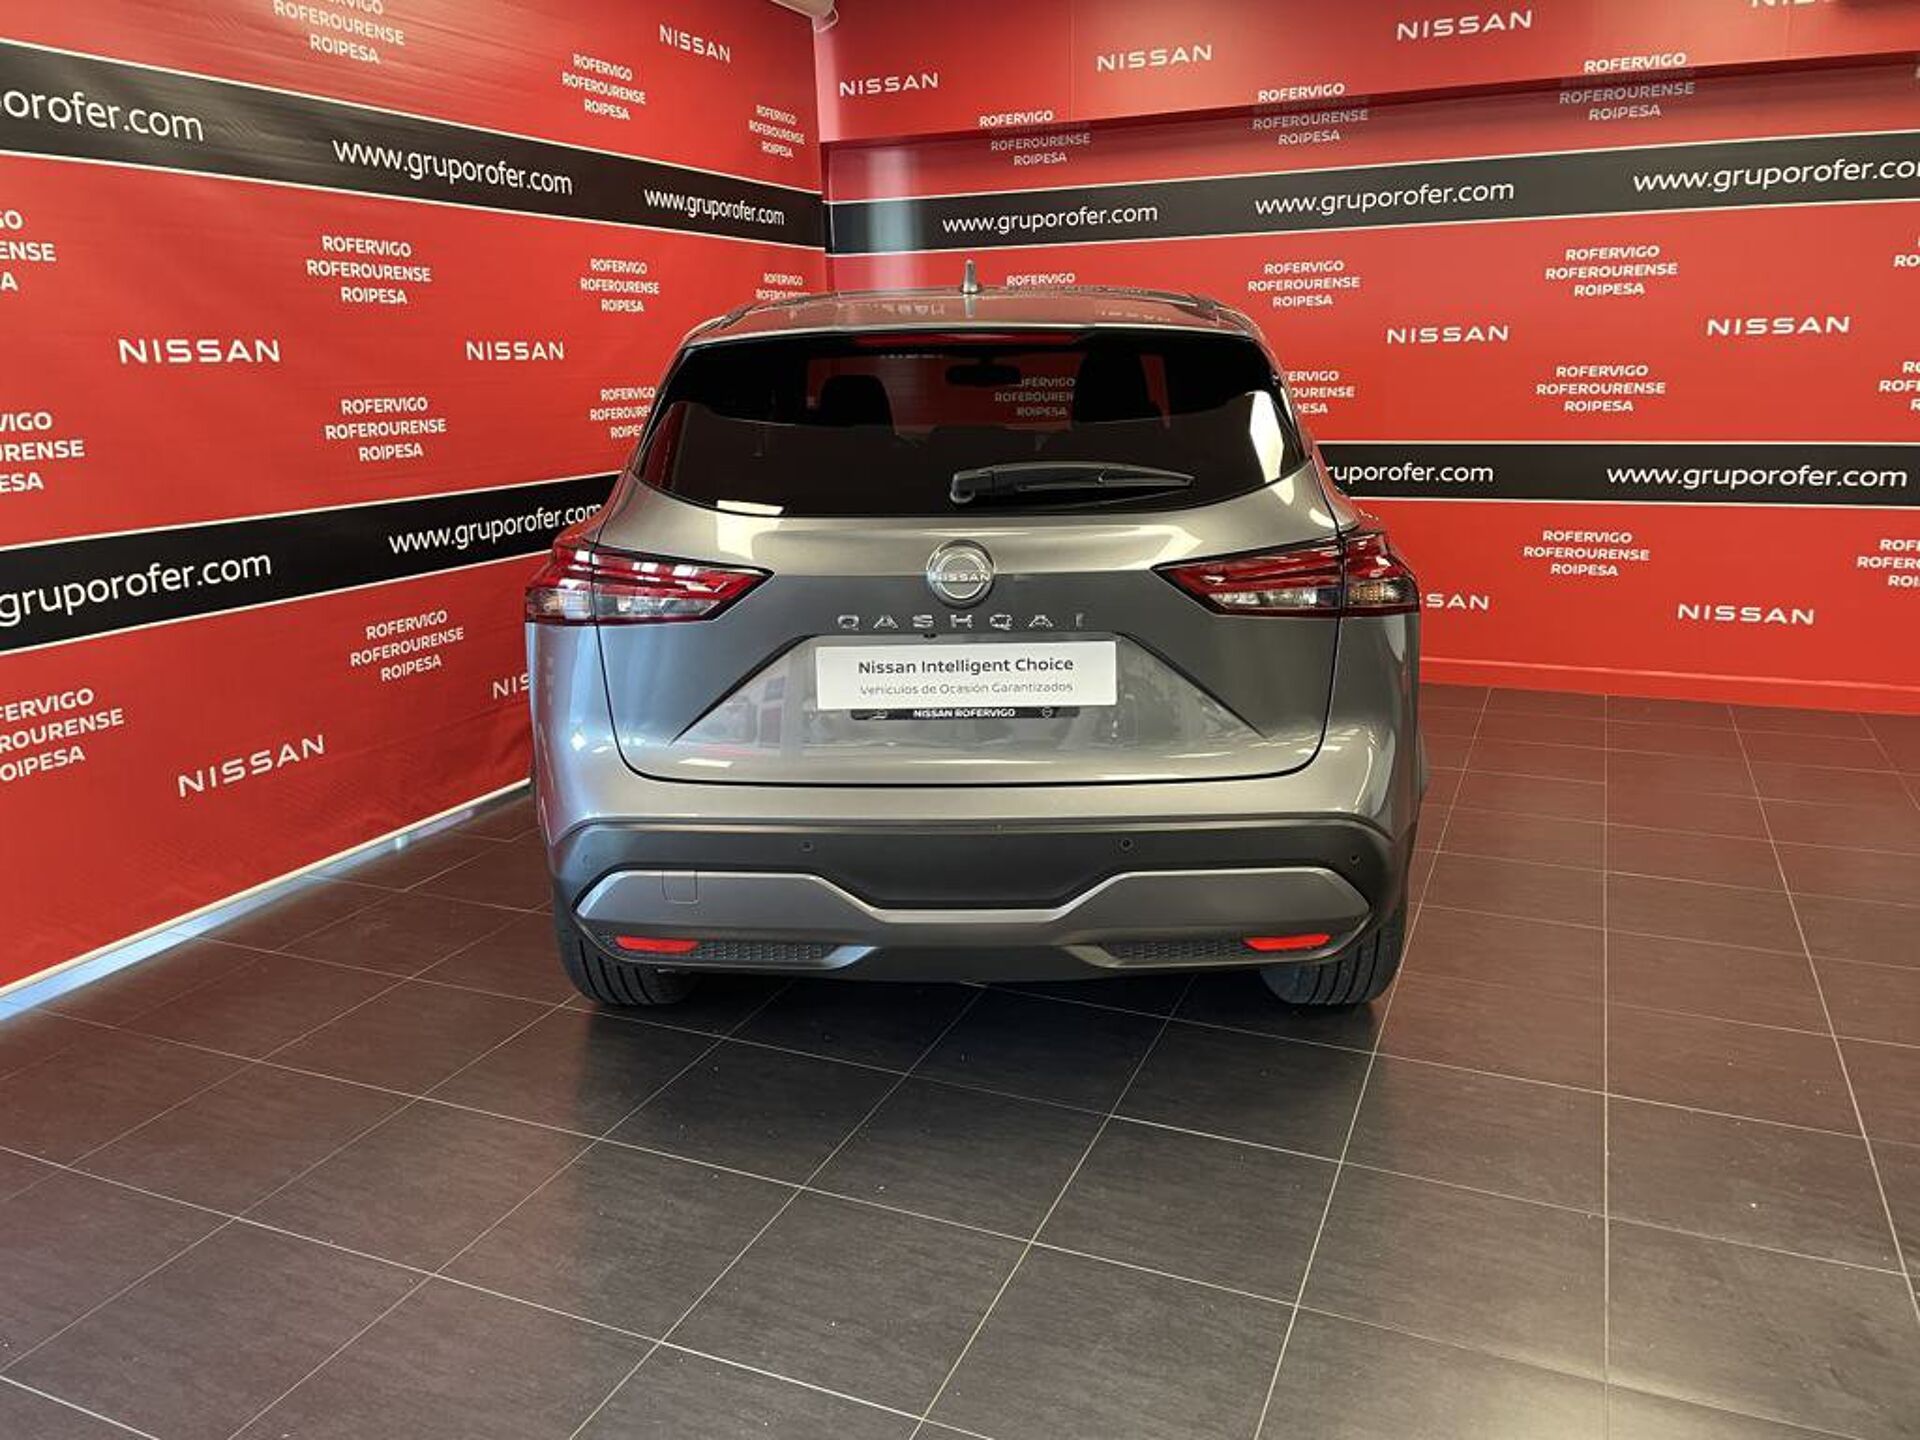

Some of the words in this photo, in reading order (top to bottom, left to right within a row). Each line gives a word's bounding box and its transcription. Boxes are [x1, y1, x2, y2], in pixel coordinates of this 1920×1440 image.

[273, 0, 405, 46] ROFEROURENSE
[1396, 10, 1533, 41] NISSAN
[309, 33, 381, 65] ROIPESA
[659, 23, 731, 63] NISSAN
[572, 53, 633, 82] ROFERVIGO
[1096, 44, 1212, 72] NISSAN
[1584, 52, 1687, 74] ROFERVIGO
[562, 72, 646, 104] ROFEROURENSE
[839, 72, 938, 97] NISSAN
[1258, 83, 1345, 103] ROFERVIGO
[1559, 82, 1695, 104] ROFEROURENSE
[0, 90, 204, 142] orofer.com
[584, 99, 630, 120] ROIPESA
[756, 104, 796, 125] ROFERVIGO
[979, 110, 1053, 127] ROFERVIGO
[1253, 109, 1368, 130] ROFEROURENSE
[1589, 104, 1661, 121] ROIPESA
[749, 120, 805, 145] ROFEROURENSE
[991, 132, 1092, 151] ROFEROURENSE
[1279, 129, 1340, 145] ROIPESA
[761, 140, 794, 158] ROIPESA
[1014, 152, 1067, 166] ROIPESA
[332, 139, 573, 196] www.gruporofer.com
[1633, 158, 1920, 193] www.gruporofer.co
[643, 188, 785, 227] www.gruporofer.com
[1255, 180, 1515, 215] www.gruporofer.com
[942, 203, 1159, 236] www.gruporofer.com
[322, 235, 411, 258] ROFERVIGO
[1565, 244, 1660, 262] ROFERVIGO
[306, 259, 431, 283] ROFEROURENSE
[590, 258, 647, 275] ROFERVIGO
[1264, 260, 1344, 275] ROFERVIGO
[1545, 261, 1678, 280] ROFEROURENSE
[580, 276, 660, 295] ROFEROURENSE
[1006, 272, 1076, 287] ROFERVIGO
[1248, 276, 1360, 291] ROFEROURENSE
[1574, 281, 1645, 298] ROIPESA
[341, 286, 407, 305] ROIPESA
[601, 298, 644, 313] ROIPESA
[1272, 293, 1333, 307] ROIPESA
[1386, 325, 1509, 345] NISSAN
[1707, 315, 1851, 337] NISSAN
[118, 338, 281, 365] NISSAN
[465, 340, 565, 362] NISSAN
[1556, 365, 1649, 378] ROFERVIGO
[1536, 381, 1666, 396] ROFEROURENSE
[341, 396, 428, 416] ROFERVIGO
[1564, 399, 1634, 413] ROIPESA
[325, 418, 446, 440] ROFEROURENSE
[359, 443, 423, 462] ROIPESA
[1606, 463, 1908, 490] www.gruporofer.com
[1542, 530, 1633, 544] ROFERVIGO
[1523, 546, 1650, 562] ROFEROURENSE
[1550, 562, 1619, 577] ROIPESA
[0, 554, 271, 627] gruporofer.com
[1420, 593, 1489, 610] SAN
[366, 610, 447, 640] ROFERVIGO
[838, 614, 1085, 630] QASHQAI
[1677, 604, 1815, 625] NISSAN
[350, 627, 464, 667] ROFEROURENSE
[381, 656, 442, 682] ROIPESA
[858, 660, 916, 674] Nissan
[922, 659, 1010, 676] Intelligent
[1016, 657, 1074, 672] Choice
[493, 673, 529, 700] NIS
[922, 684, 937, 694] de
[913, 709, 953, 718] NISSAN
[955, 708, 1015, 718] ROFERVIGO
[178, 735, 326, 798] NISSAN
